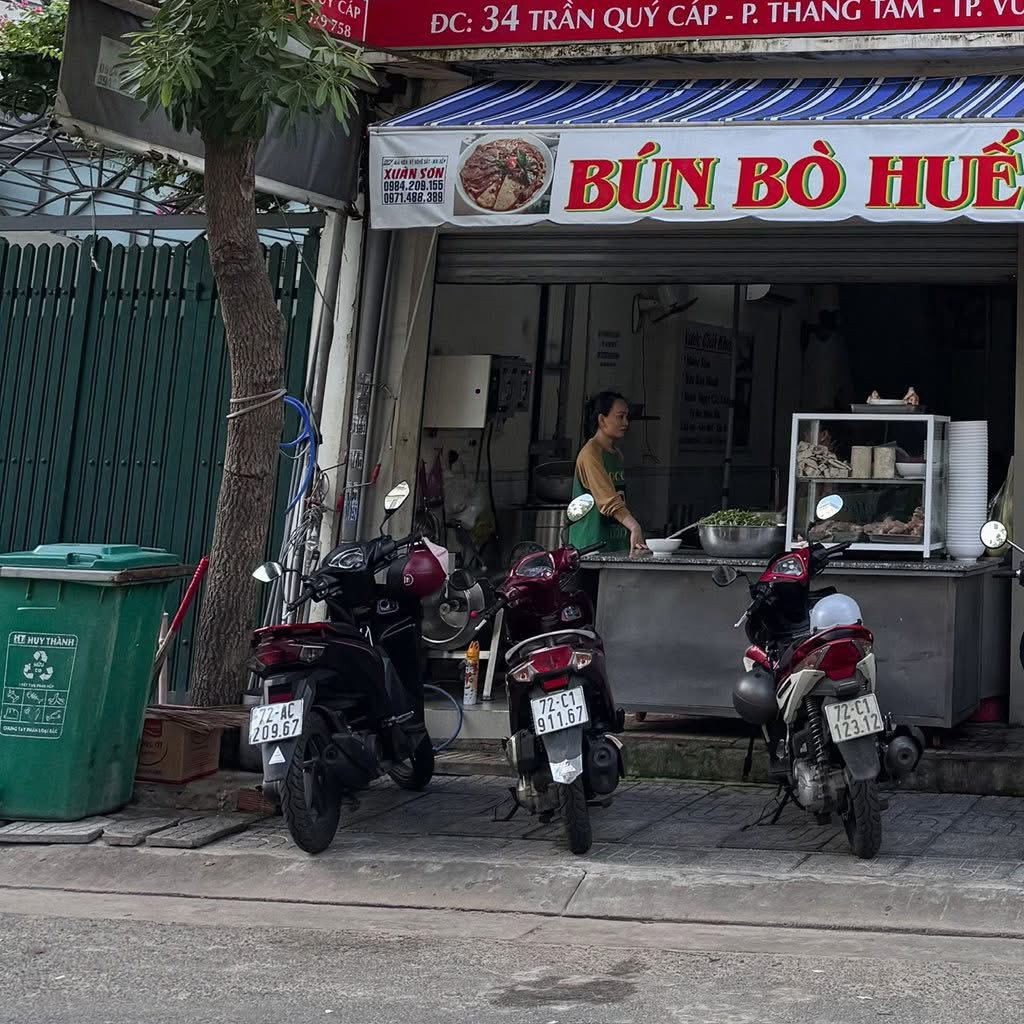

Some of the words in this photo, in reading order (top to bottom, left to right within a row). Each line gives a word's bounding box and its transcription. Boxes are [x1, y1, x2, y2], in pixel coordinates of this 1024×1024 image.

[337, 0, 361, 19] CÁP
[430, 12, 473, 36] ĐC:
[481, 4, 520, 33] 34
[603, 0, 660, 35] QUÝ
[667, 0, 718, 28] CÁP
[741, 2, 759, 25] P.
[331, 18, 352, 38] 758
[384, 165, 418, 179] XUÂN
[418, 166, 445, 179] SƠN
[564, 141, 721, 213] BÚN
[732, 139, 847, 211] BÒ
[27, 635, 46, 645] HUY
[46, 635, 75, 647] THÀNH
[257, 703, 296, 725] 72-AC
[538, 691, 575, 715] 72-C1
[834, 697, 871, 720] 72-C1
[253, 719, 300, 742] 209.67
[537, 705, 585, 733] 911.67
[834, 713, 882, 740] 123.12
